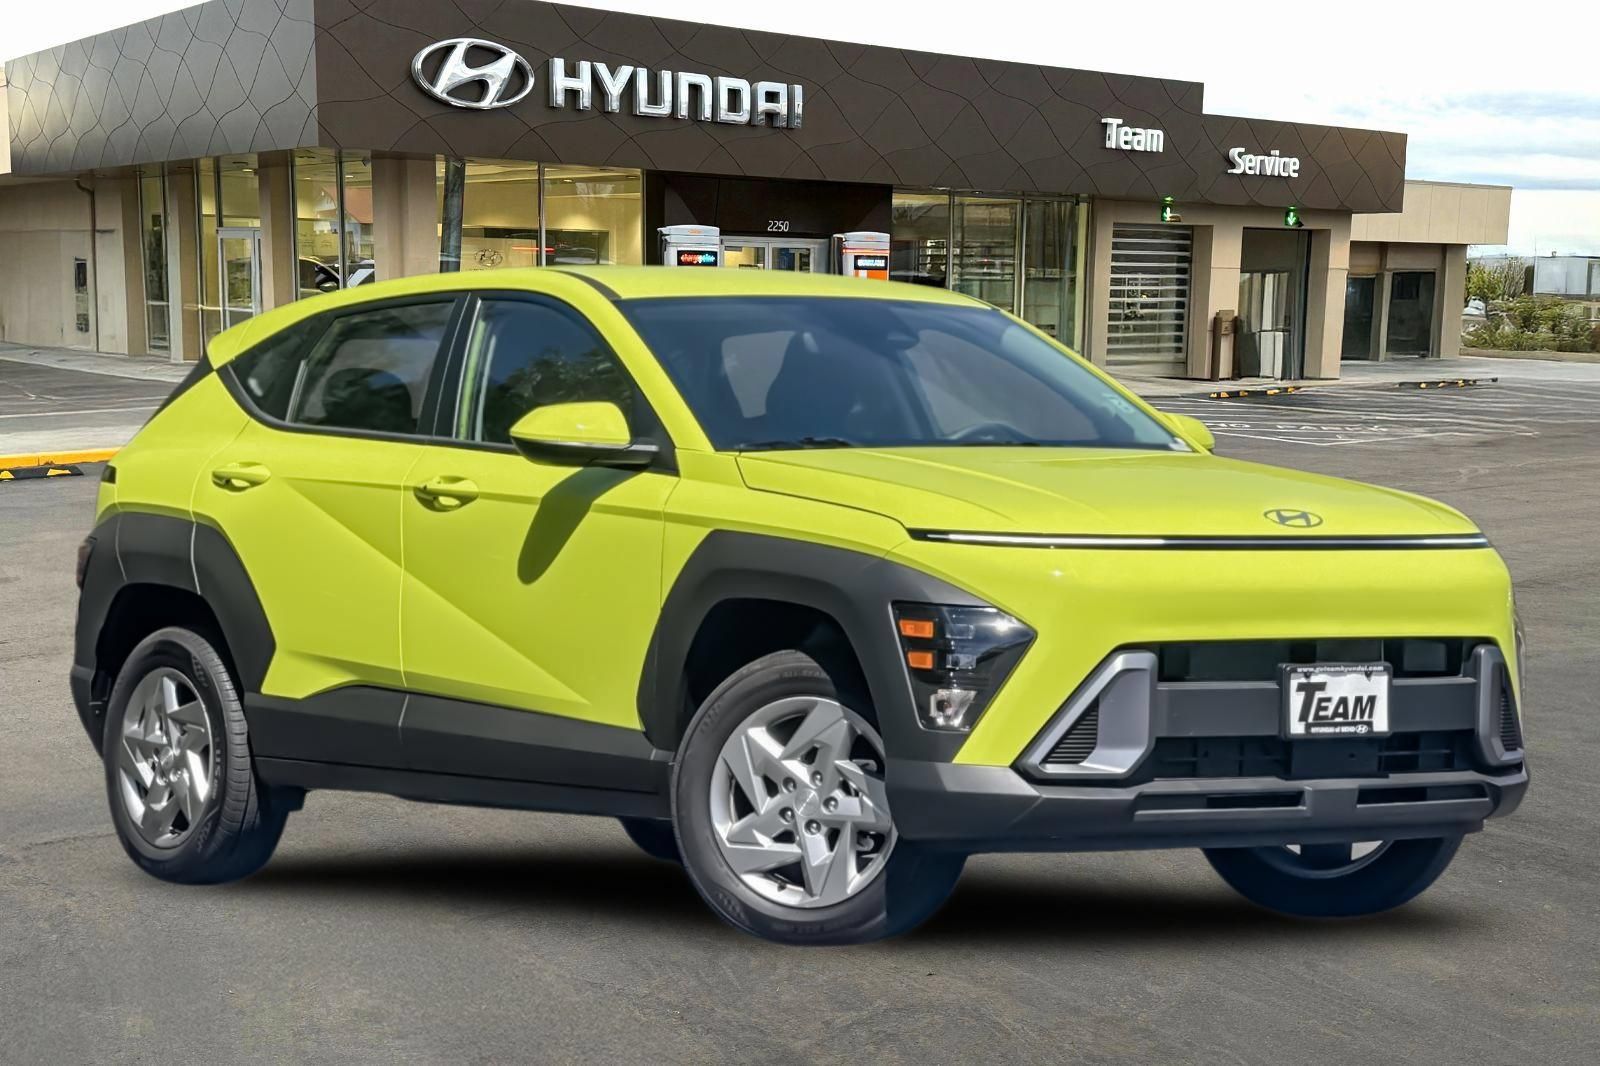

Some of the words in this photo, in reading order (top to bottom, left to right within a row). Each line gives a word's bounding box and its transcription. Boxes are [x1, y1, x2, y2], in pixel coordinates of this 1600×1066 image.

[548, 56, 803, 130] HYUNDAI
[1101, 117, 1164, 153] Team
[1227, 147, 1300, 178] Service
[767, 220, 790, 232] 2250
[1295, 681, 1378, 723] TEAM
